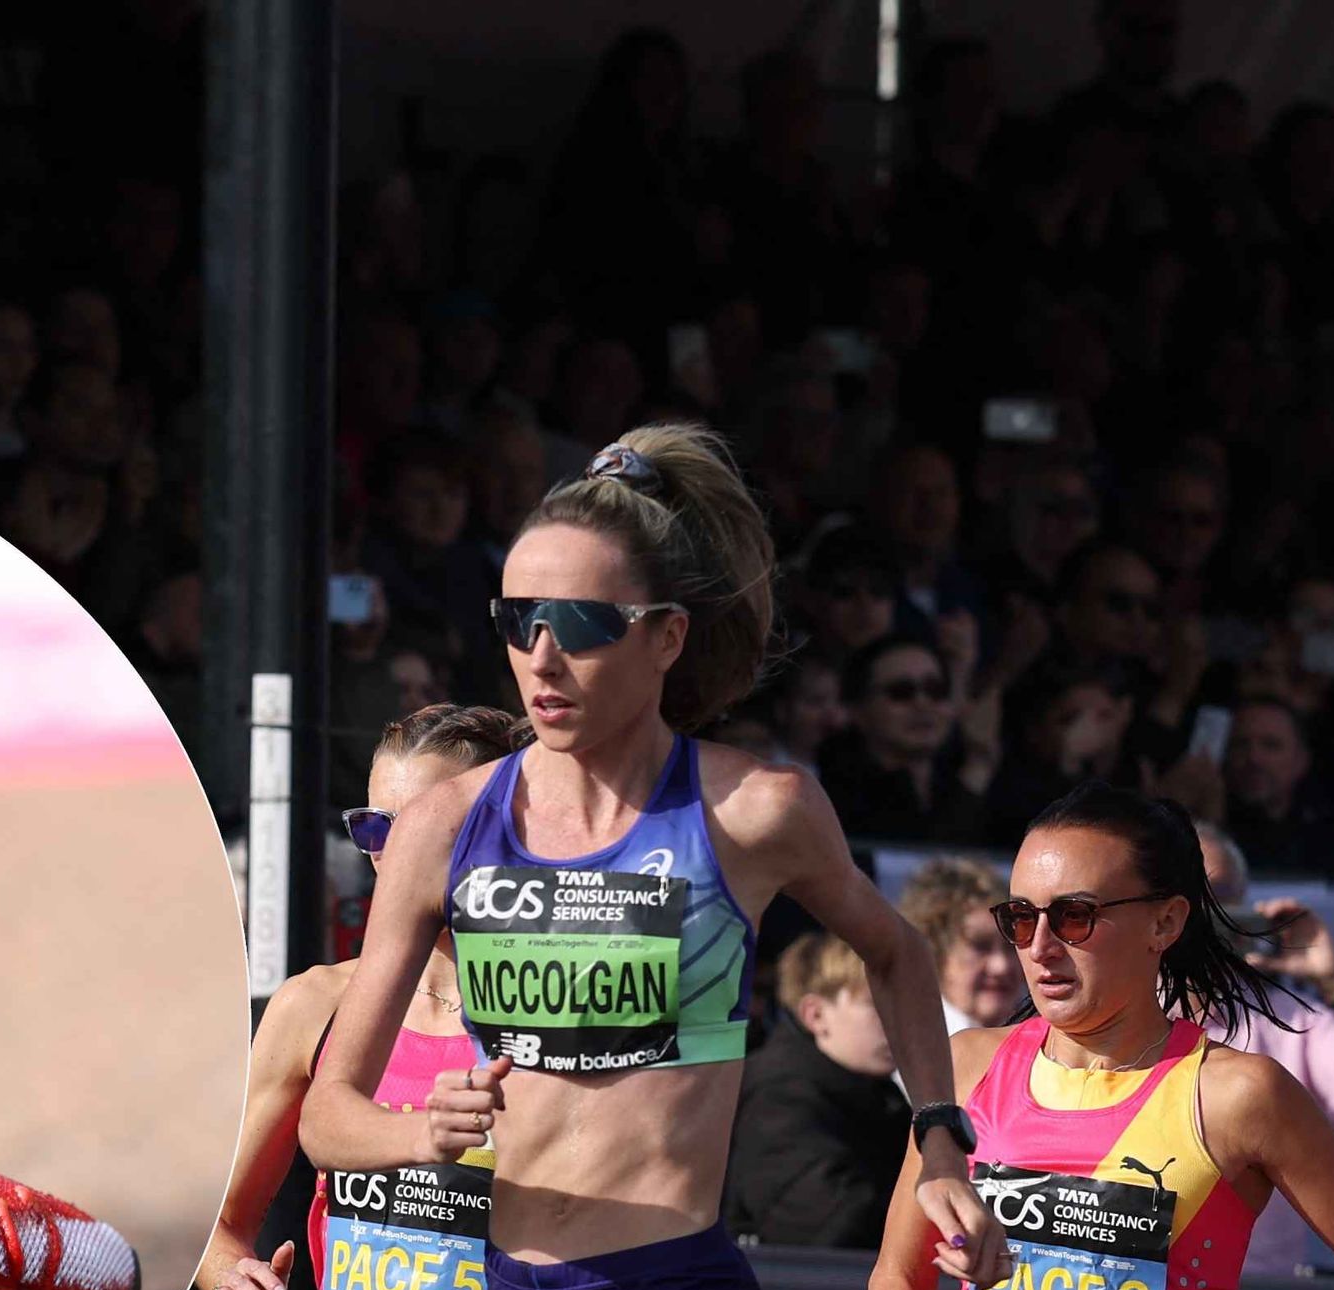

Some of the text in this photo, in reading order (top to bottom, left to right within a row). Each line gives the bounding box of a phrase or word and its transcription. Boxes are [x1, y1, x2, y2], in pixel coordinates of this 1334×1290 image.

[555, 871, 605, 886] TATA
[554, 888, 669, 905] CONSULTANCY
[552, 906, 624, 921] SERVICES
[467, 960, 666, 1014] MCCOLGAN
[544, 1055, 578, 1070] new
[580, 1049, 657, 1071] balance
[397, 1168, 438, 1185] TATA
[1057, 1187, 1099, 1206] TATA
[393, 1200, 455, 1222] SERVICES
[1054, 1204, 1158, 1232] CONSULTANCY
[1052, 1220, 1116, 1243] SERVICES
